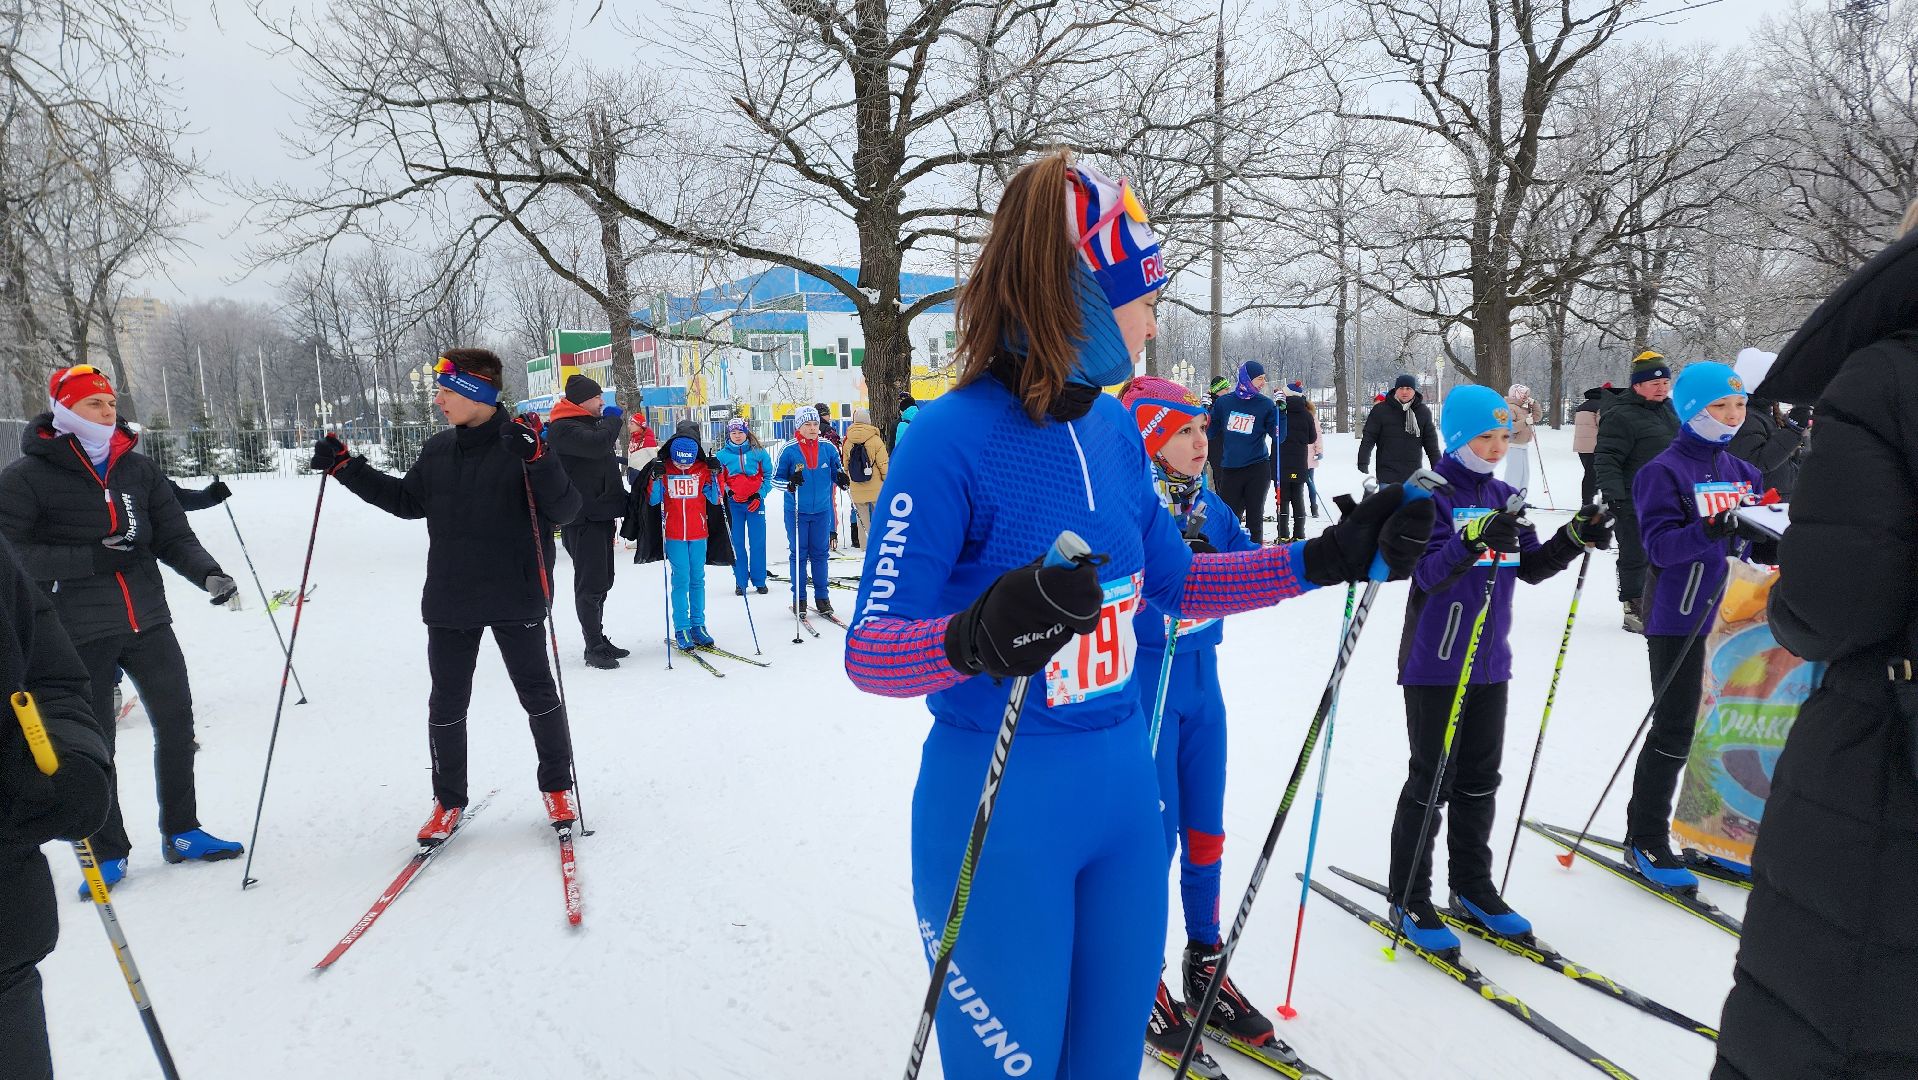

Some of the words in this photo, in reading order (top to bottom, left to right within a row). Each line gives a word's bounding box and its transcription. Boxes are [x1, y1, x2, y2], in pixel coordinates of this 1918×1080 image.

[1141, 406, 1170, 440] RUSSIA
[1232, 416, 1250, 431] 217
[674, 479, 694, 496] 196
